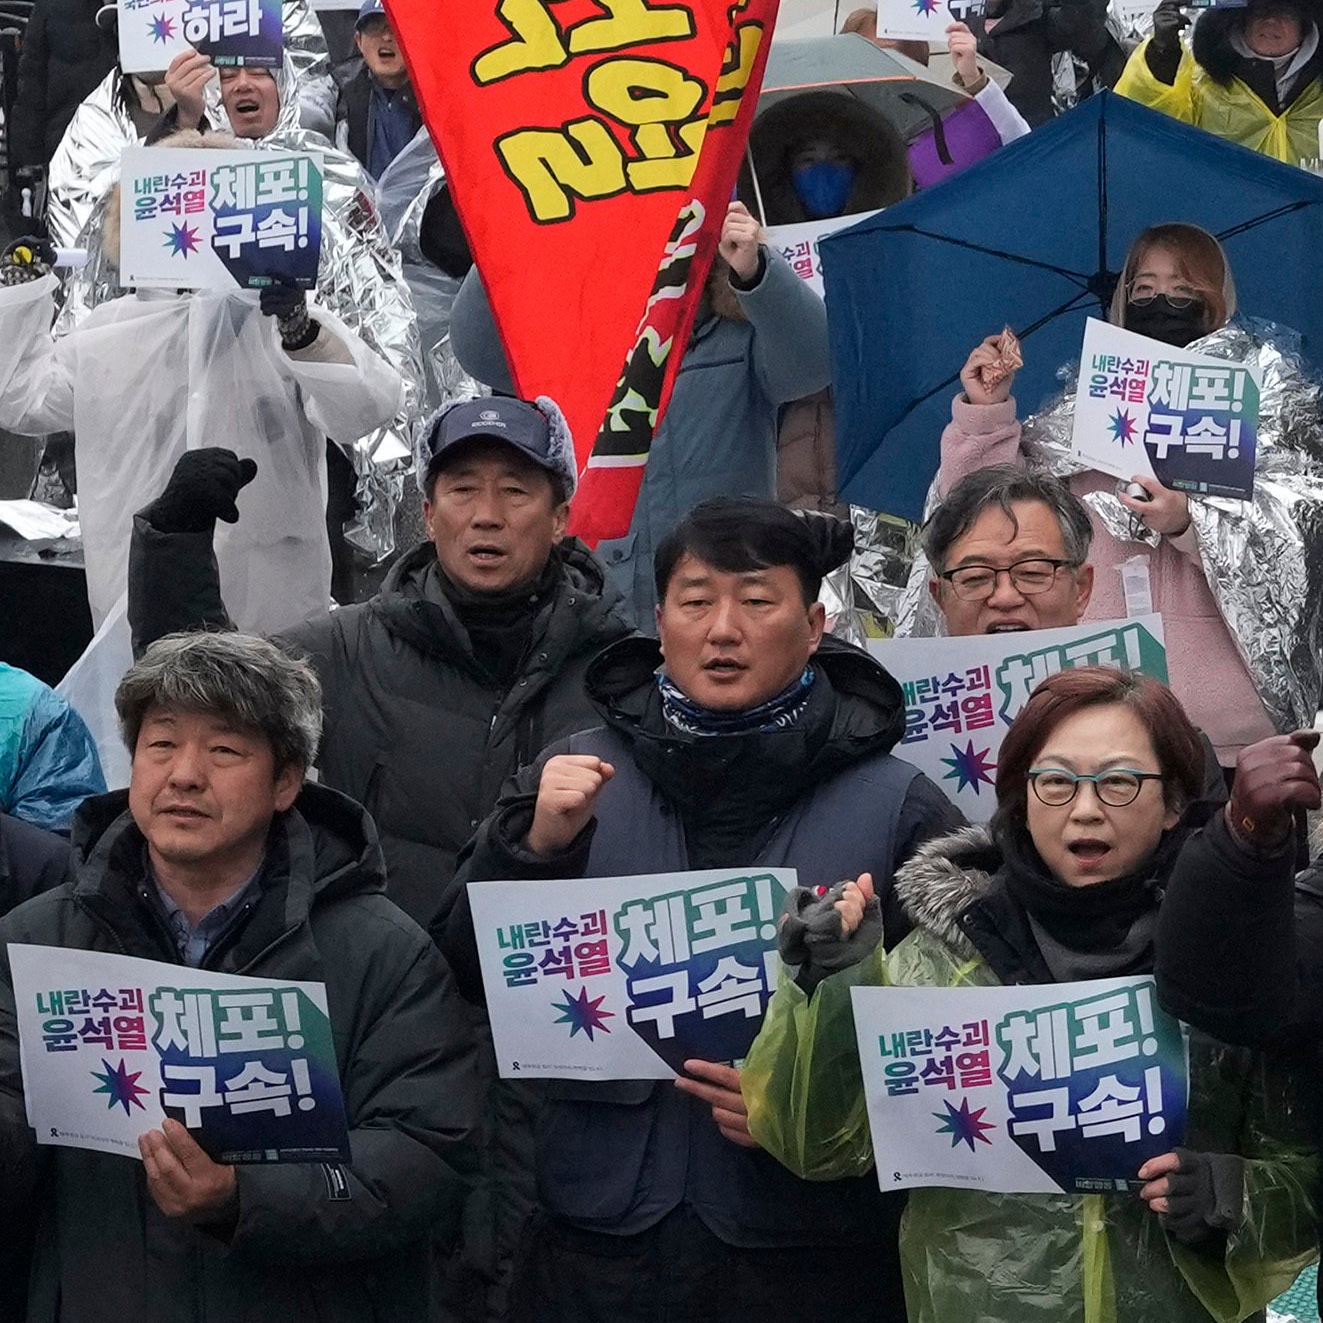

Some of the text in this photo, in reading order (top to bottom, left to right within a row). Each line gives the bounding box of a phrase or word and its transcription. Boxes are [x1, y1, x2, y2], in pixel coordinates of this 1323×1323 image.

[132, 169, 207, 197] 내란수괴
[209, 157, 310, 210] 체포!
[133, 191, 207, 219] 윤석열
[211, 207, 311, 259] 구속!
[1092, 353, 1150, 379] 내란수괴
[1089, 373, 1147, 404] 윤석열
[902, 664, 993, 708] 내란수괴
[902, 694, 995, 744] 윤석열
[496, 908, 609, 951] 내란수괴
[501, 938, 611, 988] 윤석열
[36, 987, 145, 1016] 내란수괴
[42, 1014, 149, 1052] 윤석열
[878, 1018, 990, 1060] 내란수괴
[882, 1048, 994, 1097] 윤석열
